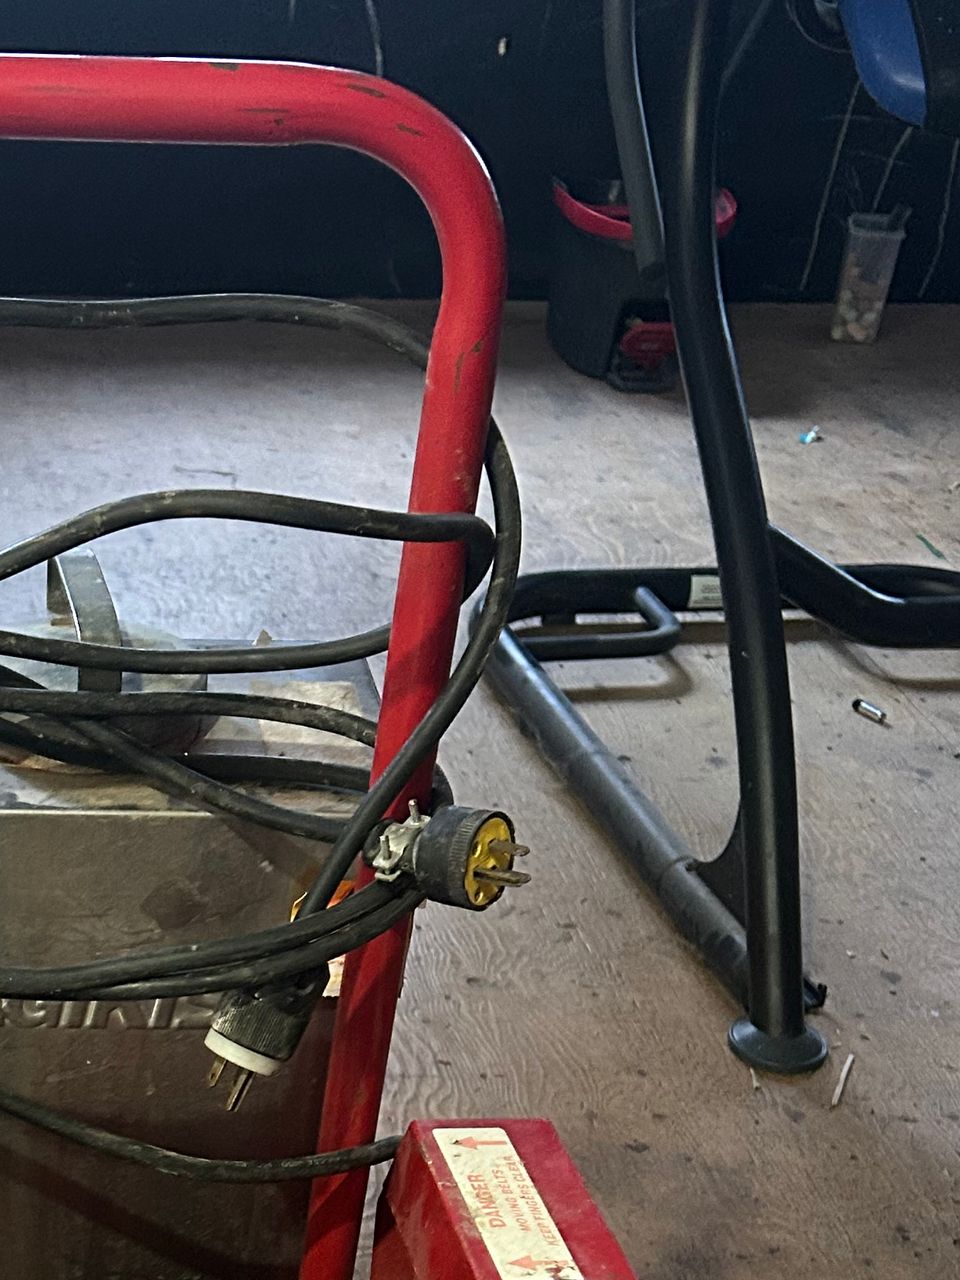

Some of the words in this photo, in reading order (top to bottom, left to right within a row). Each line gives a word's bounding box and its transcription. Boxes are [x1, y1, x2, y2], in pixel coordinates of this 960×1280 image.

[503, 1155, 526, 1181] CLEAR
[467, 1174, 507, 1228] DANGER
[504, 1197, 532, 1232] MOVING
[518, 1184, 546, 1220] FINGERS
[537, 1222, 561, 1246] KEEP
